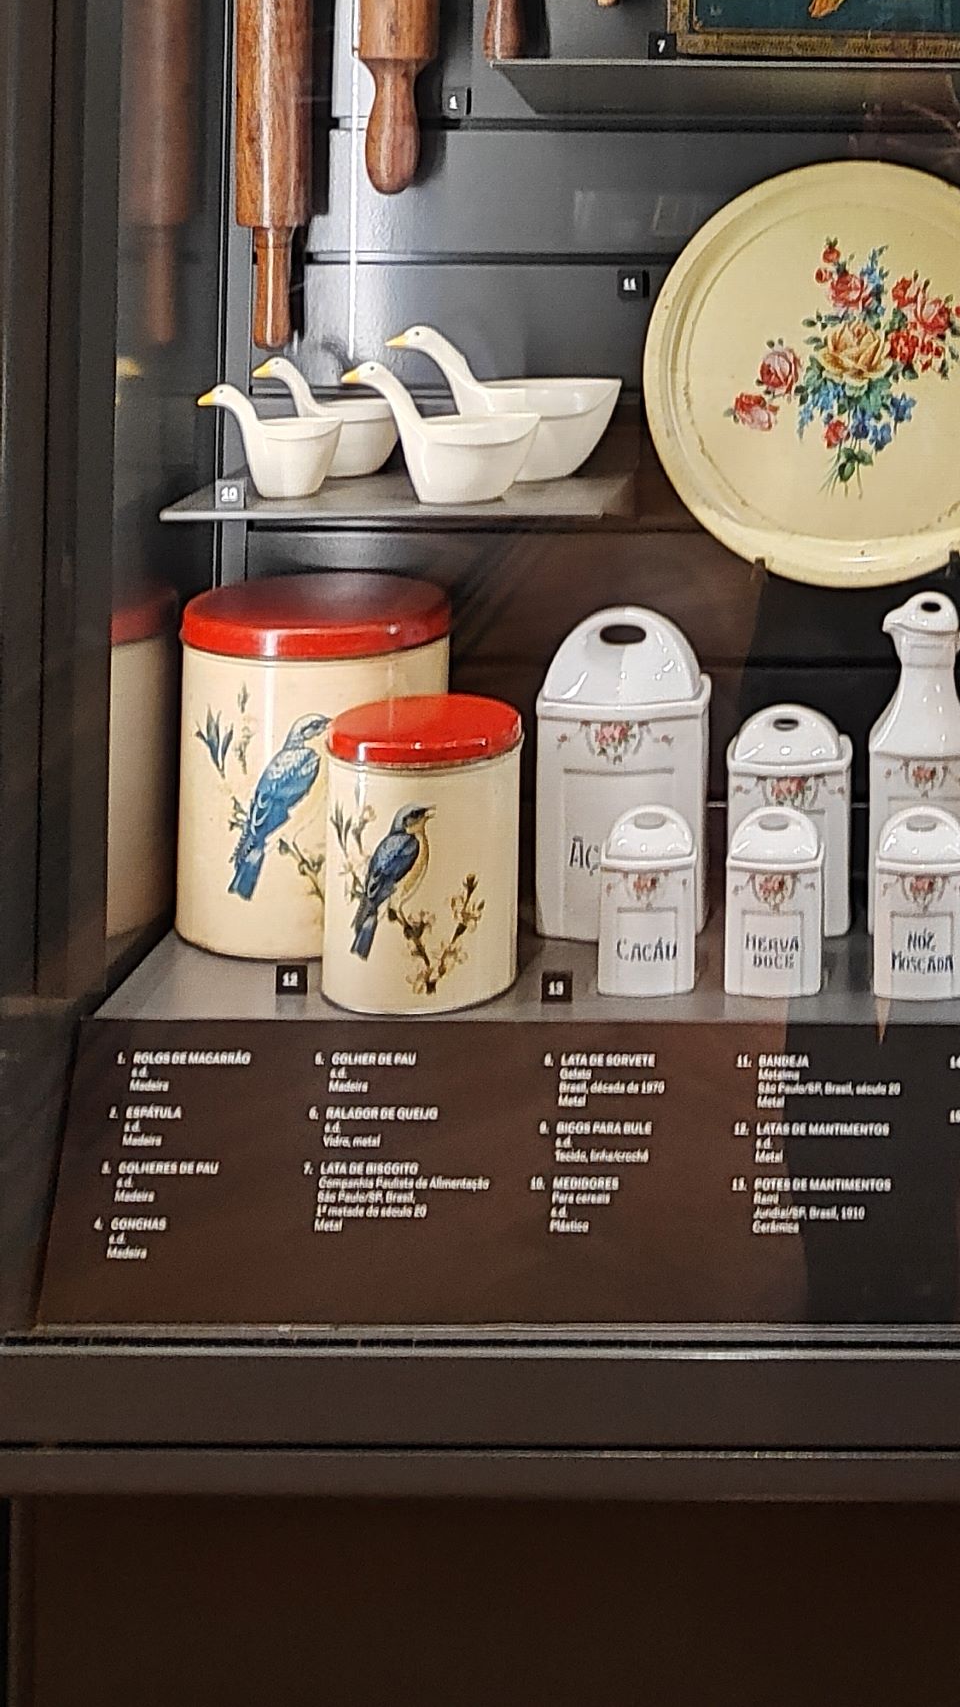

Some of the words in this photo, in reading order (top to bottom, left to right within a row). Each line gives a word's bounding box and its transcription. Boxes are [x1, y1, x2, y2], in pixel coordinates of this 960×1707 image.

[656, 39, 667, 54] 7
[220, 486, 238, 503] 10
[130, 1079, 169, 1092] Madeira
[329, 1080, 369, 1093] Madeira
[558, 1095, 586, 1107] Metal
[757, 1096, 785, 1108] Metal
[123, 1134, 162, 1147] Madeira
[323, 1135, 351, 1148] Vidro,
[352, 1135, 381, 1148] metal
[755, 1151, 783, 1164] Metal
[115, 1189, 155, 1202] Madeira
[314, 1219, 342, 1232] Metal
[549, 1220, 589, 1233] Plástico
[752, 1220, 799, 1234] Cerâmica
[107, 1245, 147, 1259] Madeira
